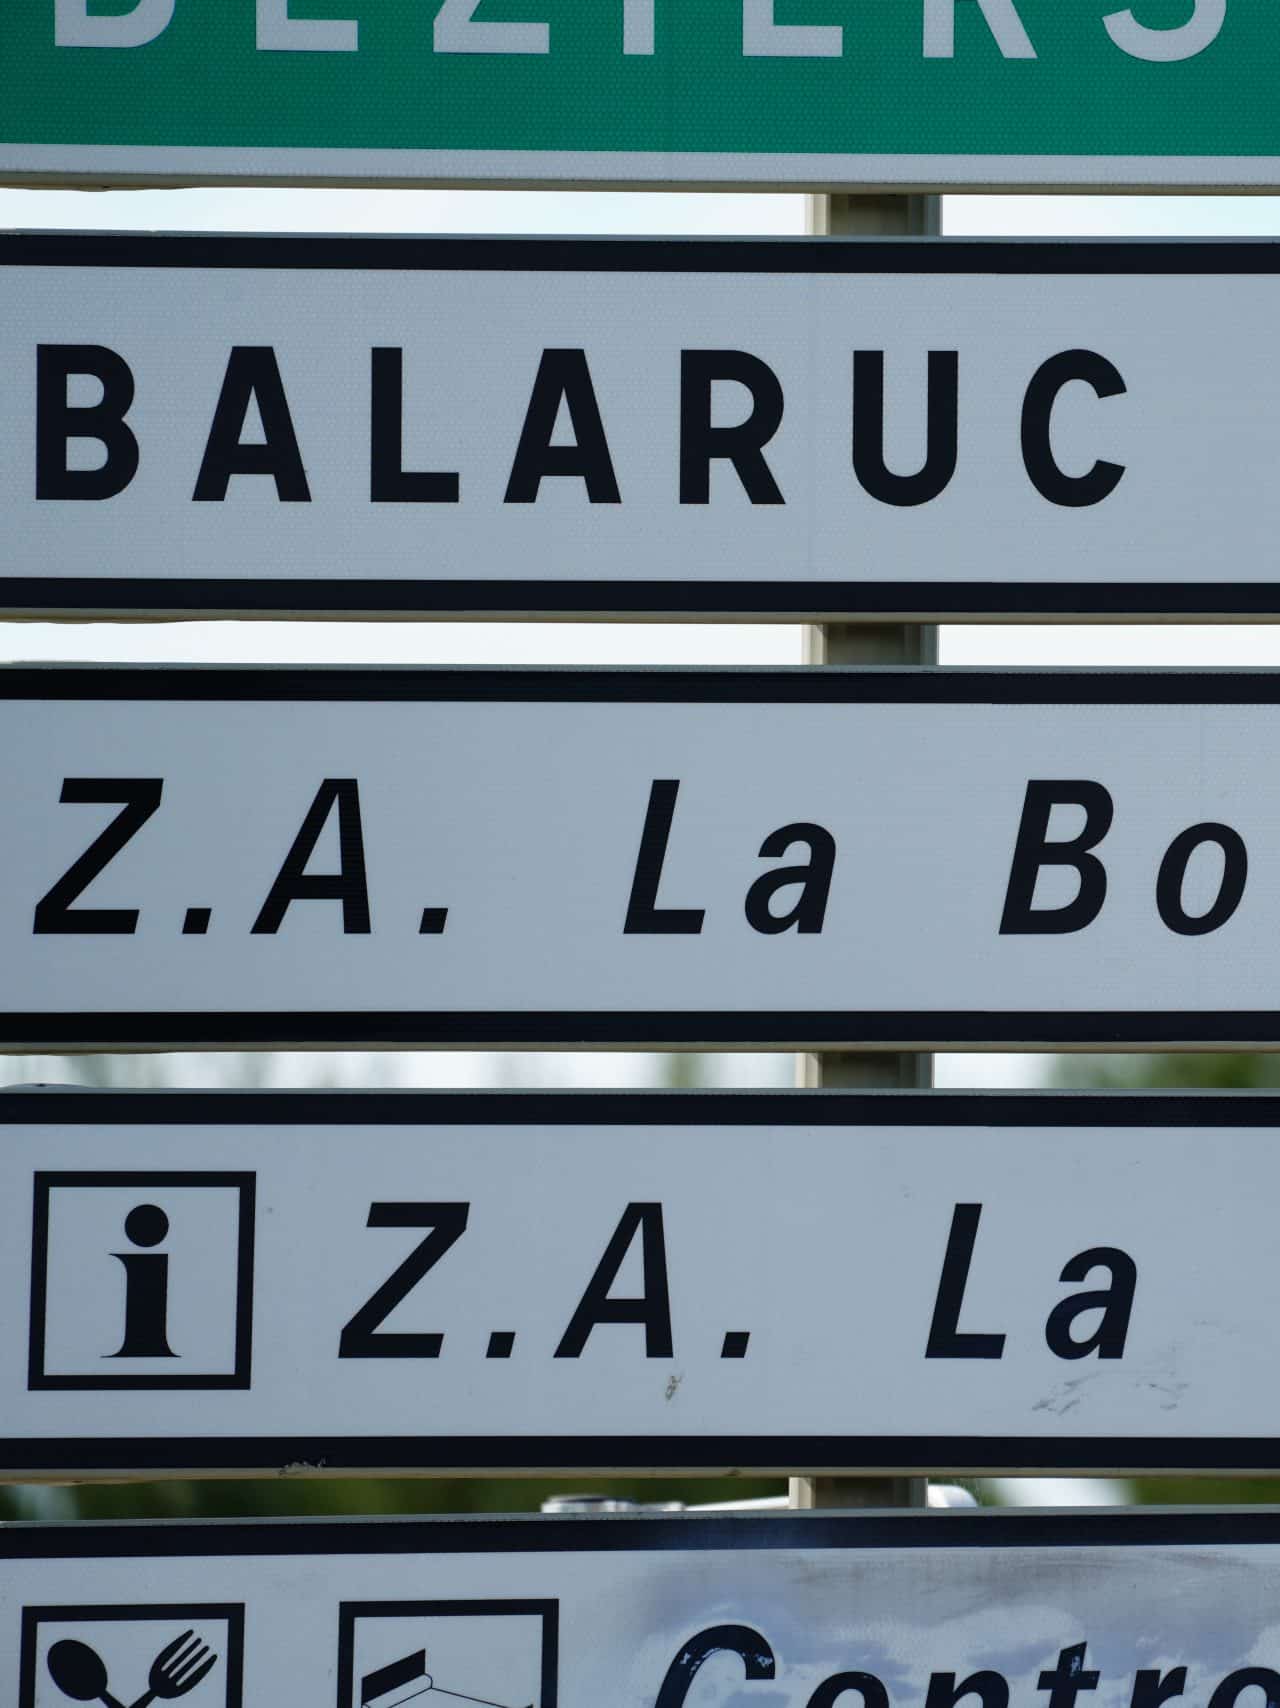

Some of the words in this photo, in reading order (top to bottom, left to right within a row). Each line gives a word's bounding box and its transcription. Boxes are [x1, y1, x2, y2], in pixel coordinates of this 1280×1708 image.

[36, 344, 1128, 507] BALARUC
[33, 776, 450, 936] Z.A.
[624, 778, 836, 936] La
[338, 1202, 752, 1359] Z.A.
[925, 1203, 1137, 1361] La
